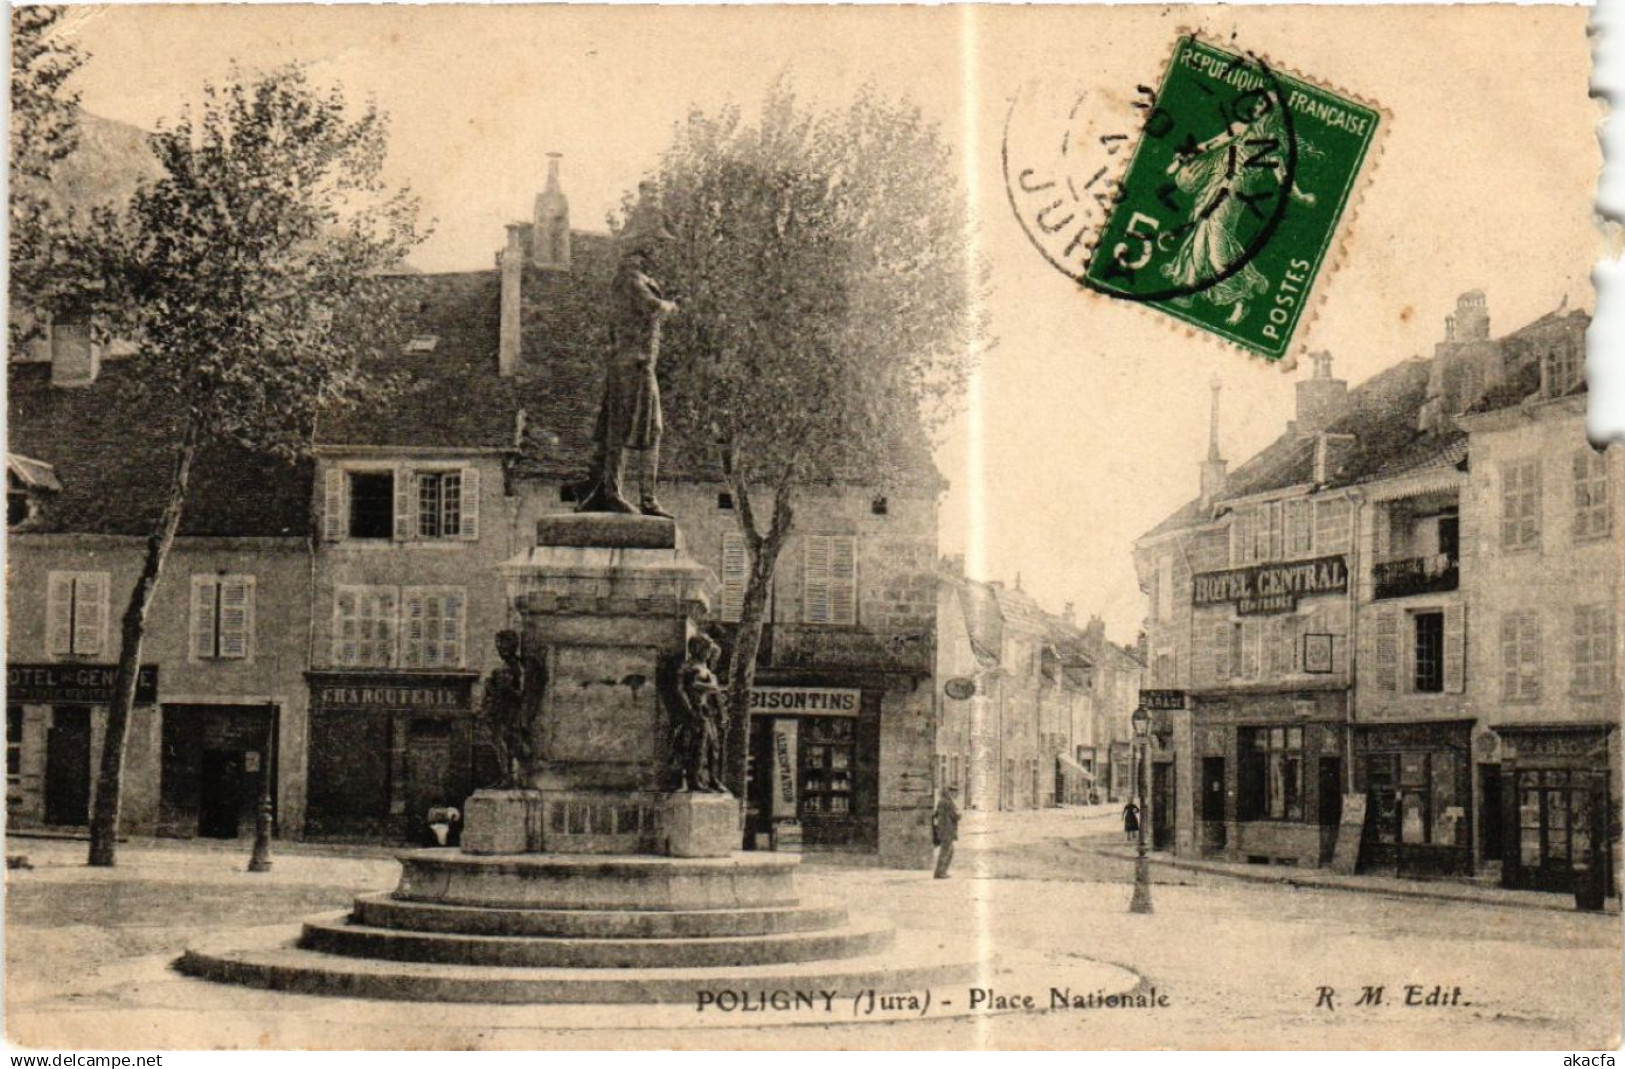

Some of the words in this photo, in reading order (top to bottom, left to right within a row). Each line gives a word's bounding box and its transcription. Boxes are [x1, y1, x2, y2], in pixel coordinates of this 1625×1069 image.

[1287, 89, 1368, 137] FRANÇAISE
[1261, 257, 1311, 341] POSTES
[1257, 562, 1346, 596] CENTRAL
[9, 668, 56, 686] OTEL
[76, 669, 152, 687] GENE
[749, 690, 855, 710] BISONTINS
